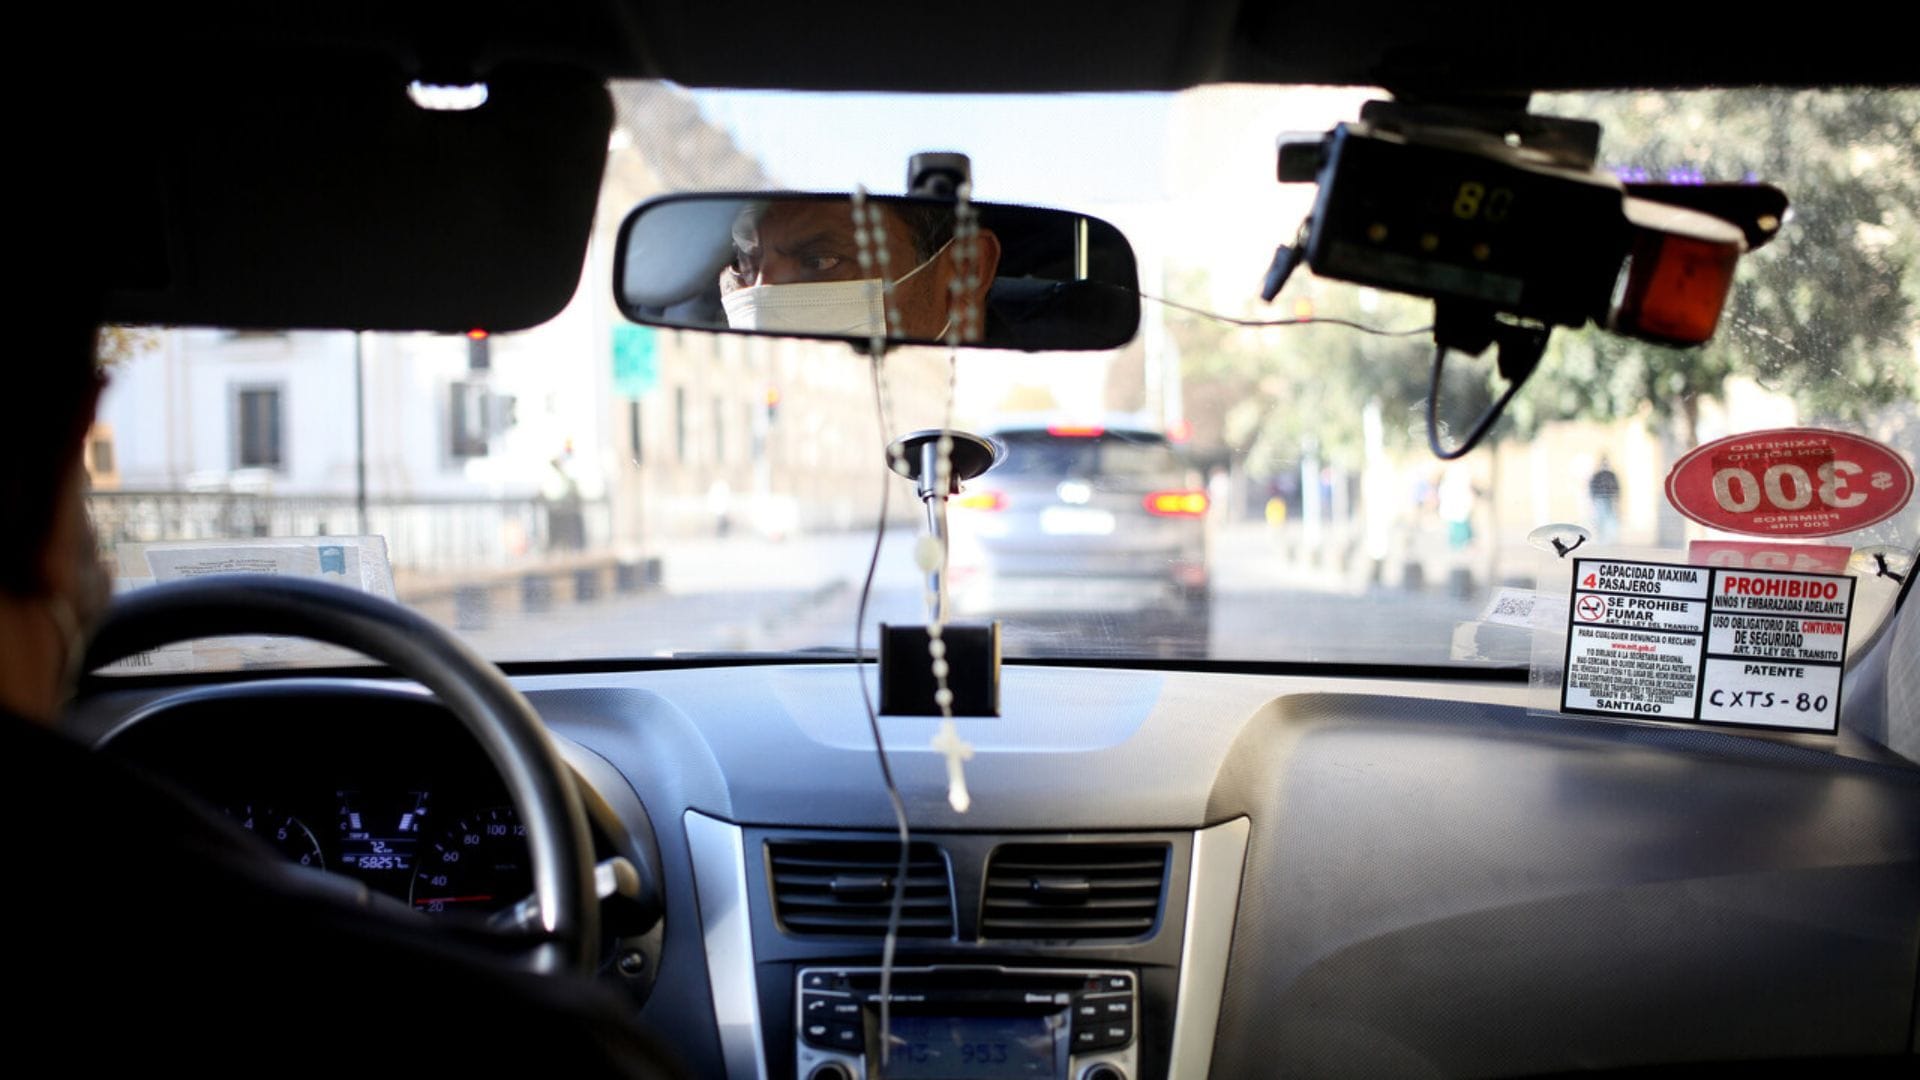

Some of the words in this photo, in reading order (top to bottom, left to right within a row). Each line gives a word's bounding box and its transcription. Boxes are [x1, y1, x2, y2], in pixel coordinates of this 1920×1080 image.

[1583, 573, 1597, 588] 4
[1600, 564, 1655, 580] CAPACIDAD
[1658, 568, 1698, 583] MAXIMA
[1599, 577, 1661, 593] PASAJEROS
[1724, 576, 1838, 600] PROHIBIDO
[1608, 597, 1625, 608] SE
[1629, 598, 1689, 613] PROHIBE
[1740, 596, 1747, 609] Y
[1747, 597, 1802, 612] EMBARAZADAS
[1804, 600, 1844, 614] ADELANTE
[1606, 608, 1654, 621] FUMAR
[1664, 622, 1699, 631] TRANSITO
[1713, 616, 1729, 629] USO
[1731, 617, 1784, 631] OBLIGATORIO
[1786, 620, 1800, 632] DEL
[1802, 621, 1843, 635] CINTURON
[1735, 630, 1748, 644] DE
[1749, 631, 1804, 647] SEGURIDAD
[1733, 645, 1750, 655] ART.
[1764, 646, 1780, 656] LEY
[1782, 648, 1795, 657] DEL
[1799, 649, 1838, 660] TRANSITO
[1744, 664, 1804, 678] PATENTE
[1597, 699, 1661, 713] SANTIAGO
[487, 824, 506, 836] 100
[513, 824, 529, 836] 12
[463, 834, 480, 845] 80
[442, 851, 459, 862] 60
[431, 875, 447, 886] 40
[428, 900, 444, 912] 20
